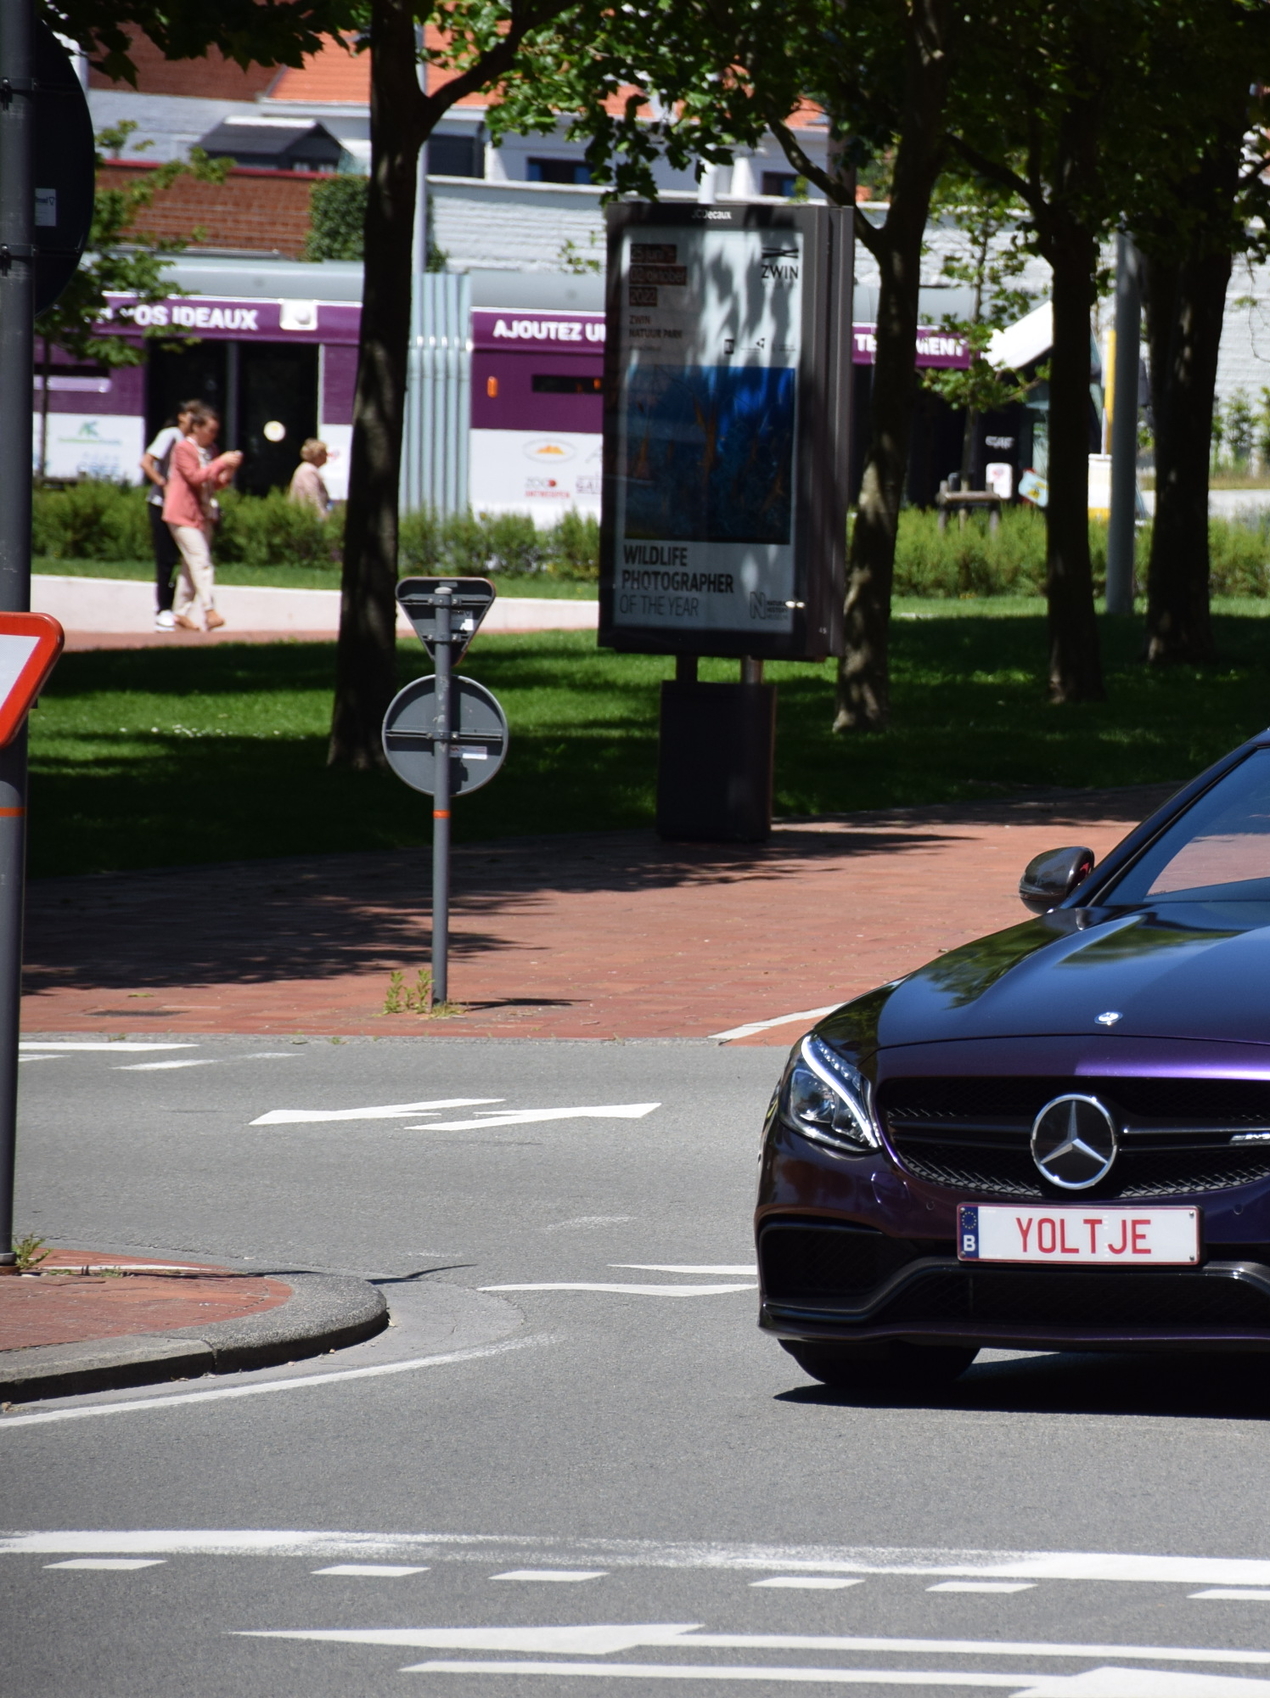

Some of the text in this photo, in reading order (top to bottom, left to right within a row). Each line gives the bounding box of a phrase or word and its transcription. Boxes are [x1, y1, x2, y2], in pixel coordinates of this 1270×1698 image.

[761, 264, 799, 280] ZWIN
[172, 306, 258, 331] IDEAUX
[493, 319, 583, 341] AJOUTEZ
[623, 545, 688, 567] WILDLIFE
[621, 570, 734, 593] PHOTOGRAPHER
[620, 594, 699, 617] OF THE YEAR
[963, 1217, 1152, 1254] B YOLTJE
